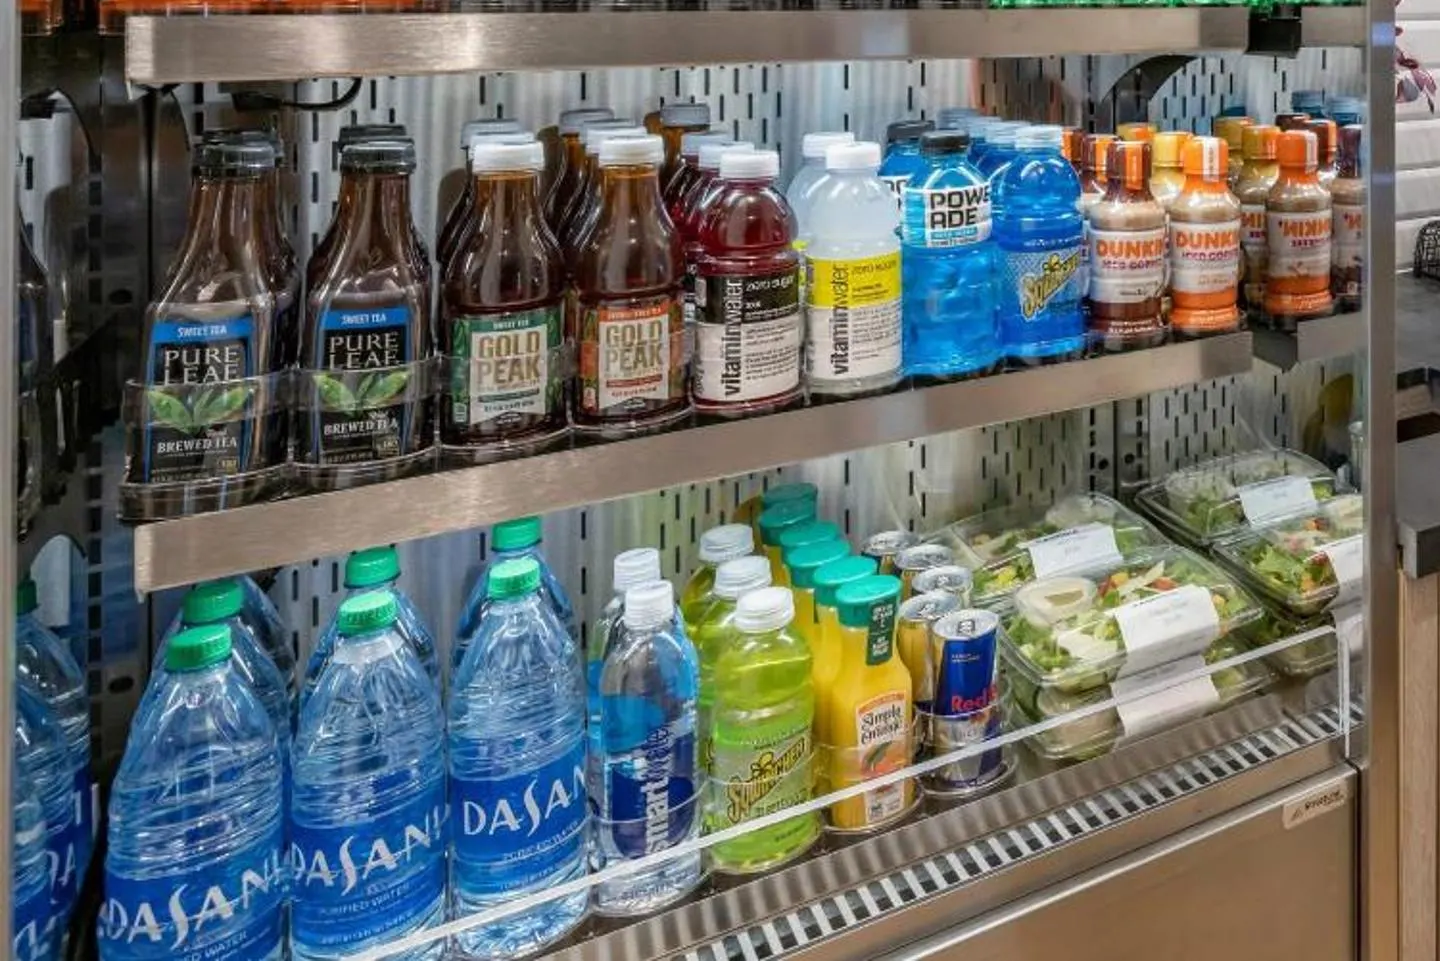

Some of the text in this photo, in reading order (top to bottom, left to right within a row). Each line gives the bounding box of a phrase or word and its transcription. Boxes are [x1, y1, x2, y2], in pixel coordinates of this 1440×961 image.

[929, 183, 991, 211] POWE
[930, 208, 978, 231] ADE
[1097, 238, 1163, 258] DUNKI
[830, 264, 850, 376] vitaminwater
[329, 331, 399, 354] PURE
[479, 330, 541, 359] GOLD
[605, 320, 662, 348] GOLD
[721, 276, 743, 397] vitaminwater
[164, 345, 240, 368] PURE
[329, 348, 399, 370] LEAF
[605, 343, 663, 372] PEAK
[164, 365, 240, 386] LEAF
[477, 355, 541, 384] PEAK
[324, 417, 398, 435] BREWED TEA
[157, 436, 238, 454] BREWED TEA
[951, 690, 988, 712] Red
[463, 765, 587, 837] DASAN
[291, 805, 441, 898] DASANI
